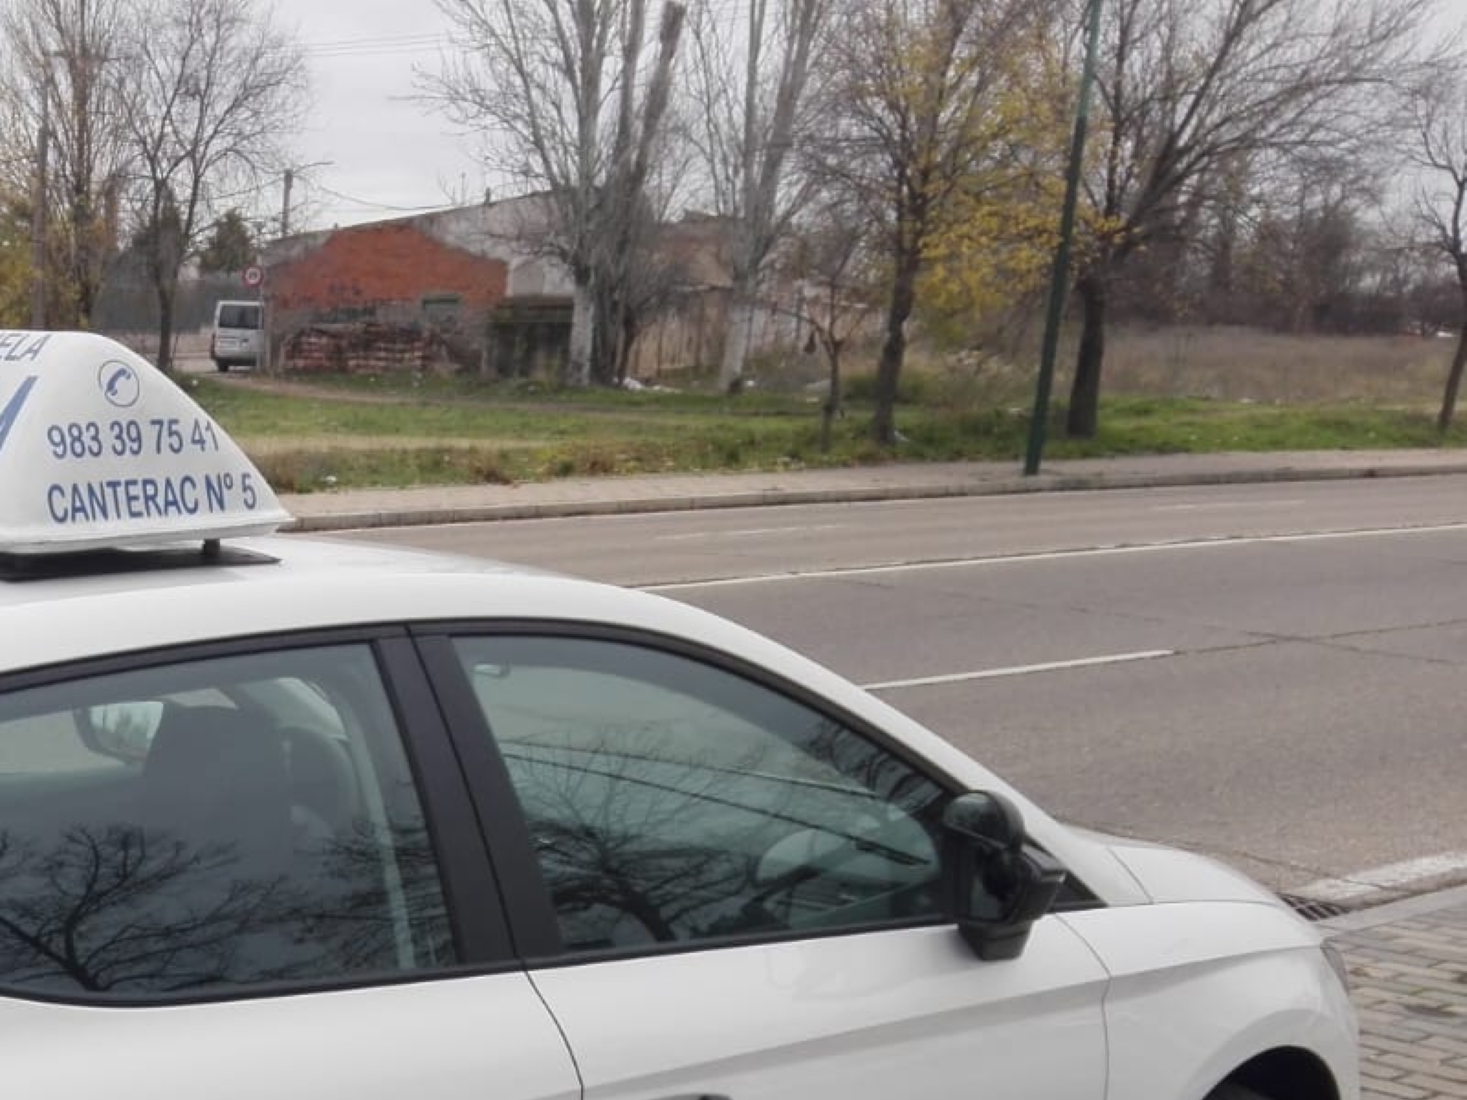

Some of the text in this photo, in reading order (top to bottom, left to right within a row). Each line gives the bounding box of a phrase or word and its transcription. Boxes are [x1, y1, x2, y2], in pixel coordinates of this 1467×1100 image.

[47, 418, 219, 459] 983 39 75 41
[47, 475, 199, 523] CANTERAC
[242, 472, 257, 510] 5
